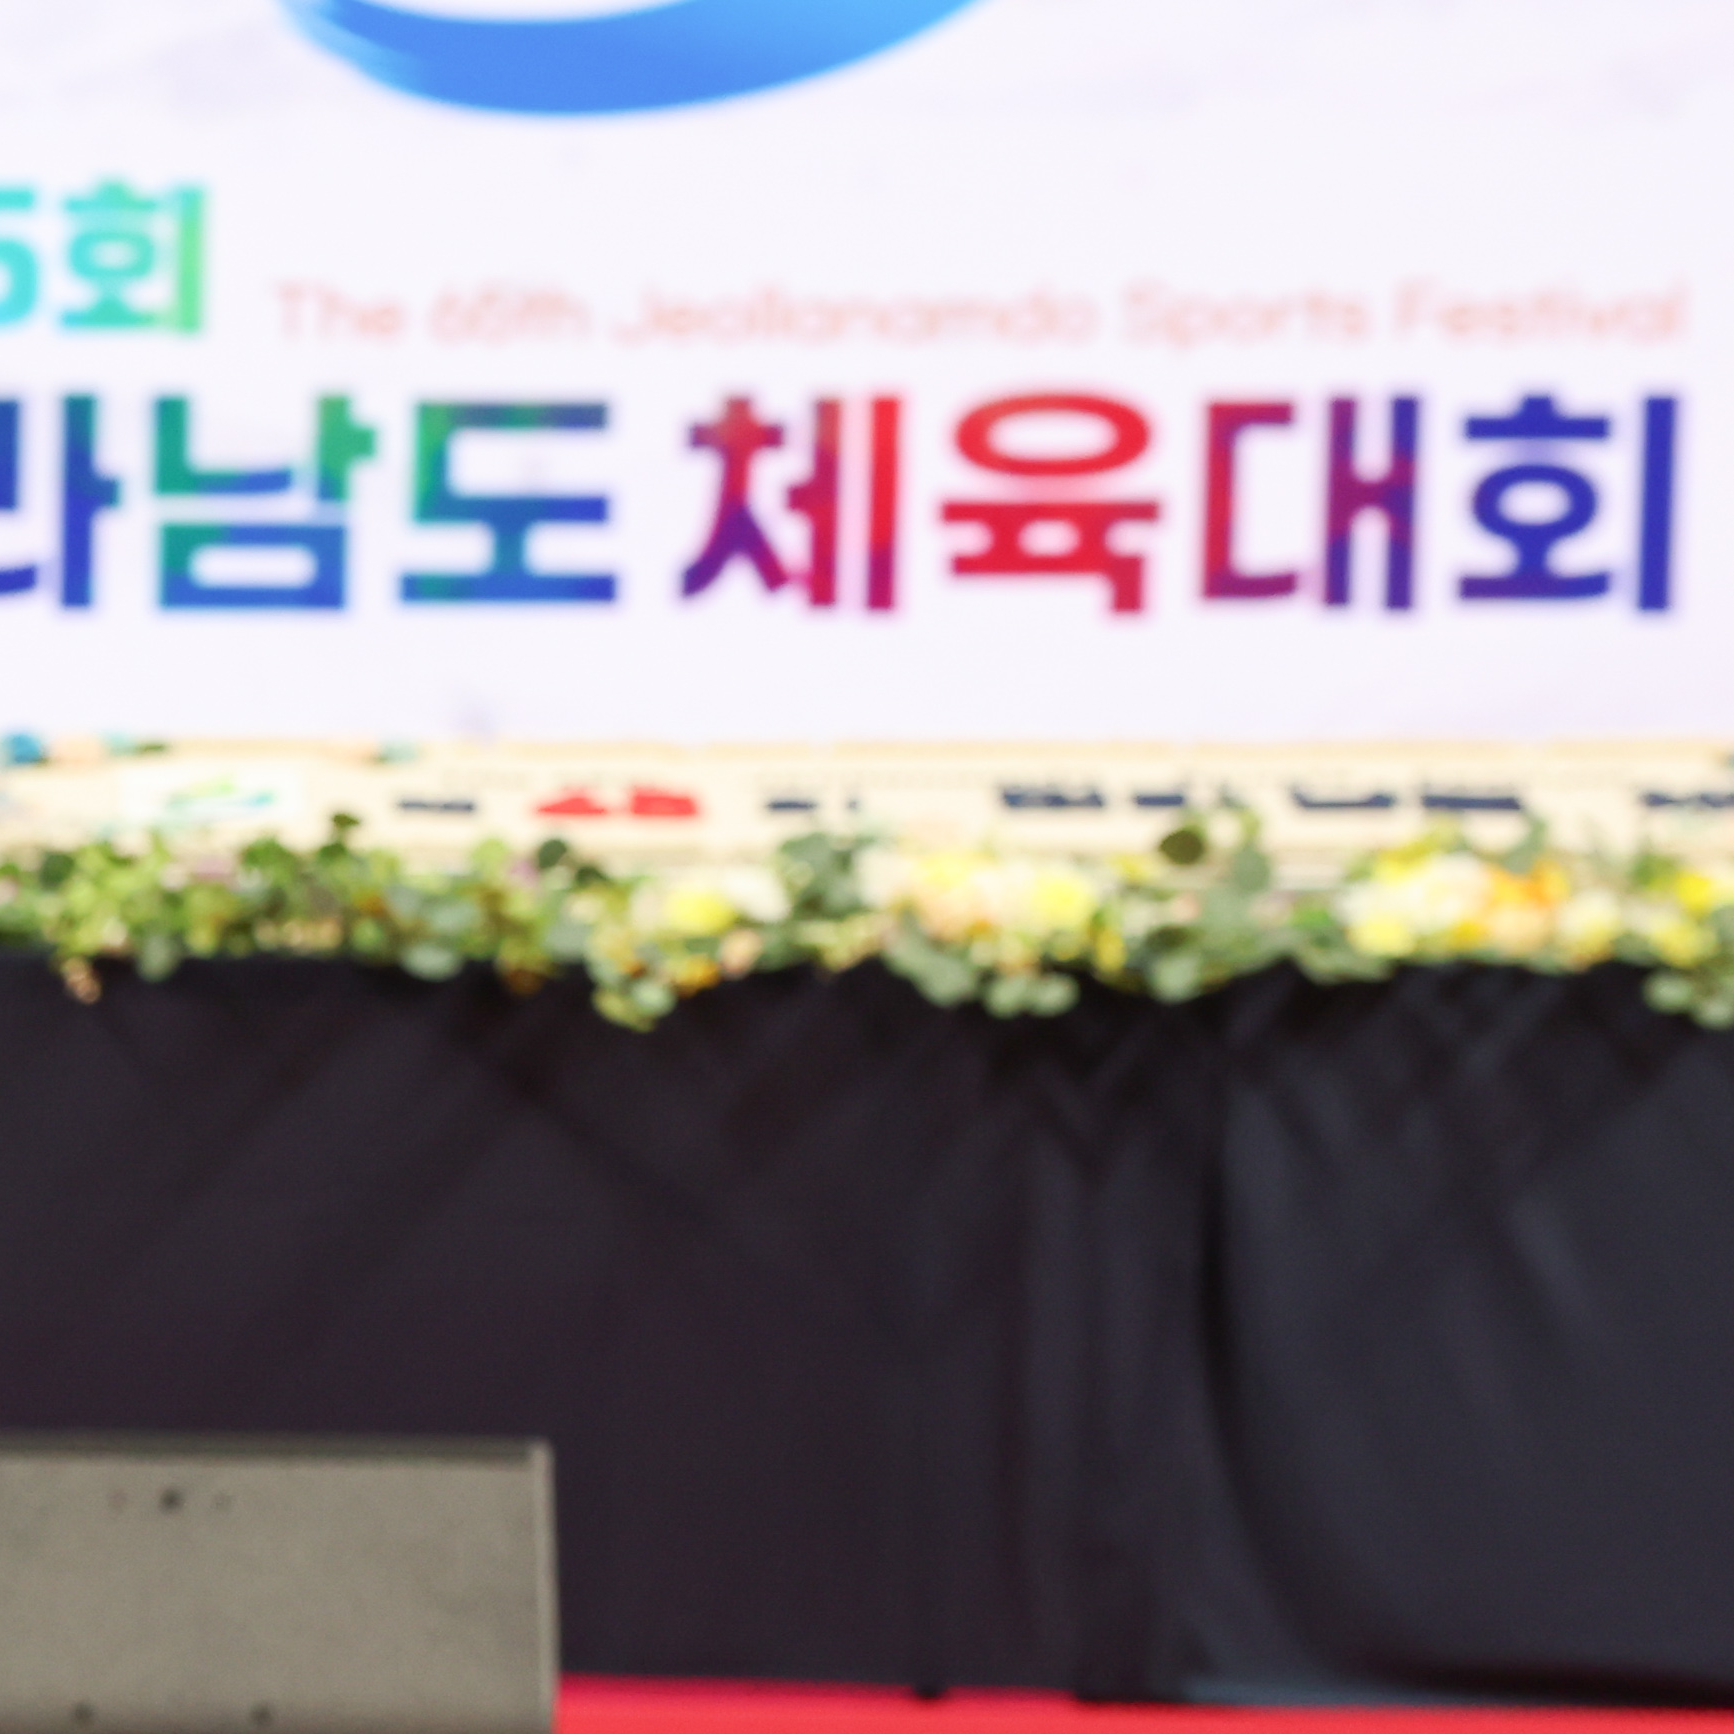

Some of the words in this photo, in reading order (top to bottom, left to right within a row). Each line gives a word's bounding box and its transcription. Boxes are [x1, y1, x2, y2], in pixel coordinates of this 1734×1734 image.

[277, 284, 403, 342] The
[1125, 284, 1369, 354] Sports
[1393, 283, 1685, 346] Festival
